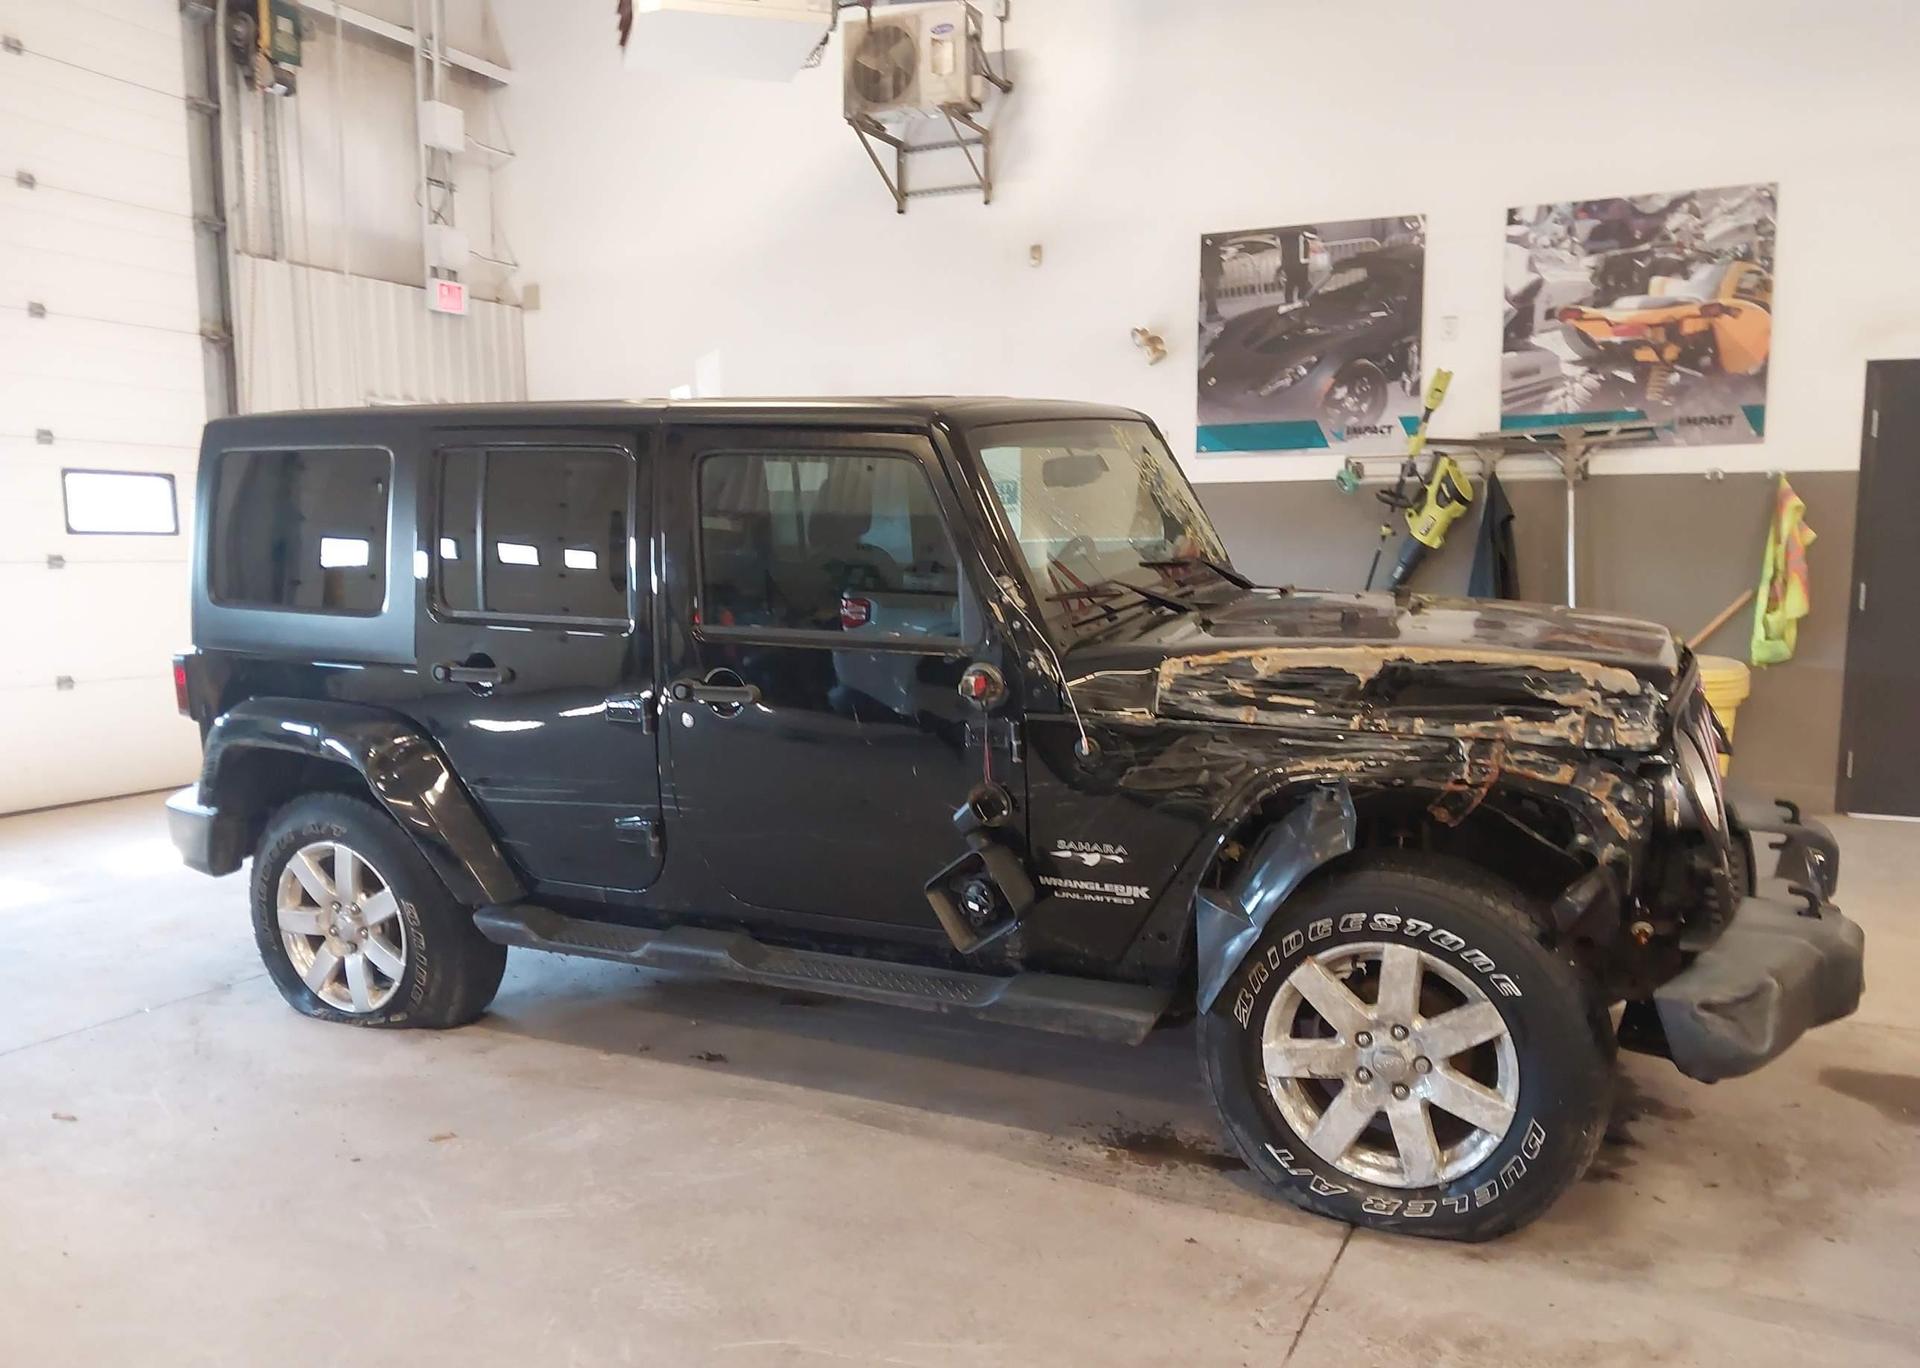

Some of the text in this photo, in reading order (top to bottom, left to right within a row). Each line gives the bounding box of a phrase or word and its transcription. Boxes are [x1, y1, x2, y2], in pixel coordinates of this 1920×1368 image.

[1678, 413, 1734, 426] IMPACT
[1346, 424, 1393, 436] IMPACT
[1056, 839, 1128, 856] SAHARA
[1054, 890, 1135, 905] UNLIMITED
[1233, 912, 1523, 1030] BRIDGESTONE
[1263, 1117, 1546, 1218] DUELER A/T
